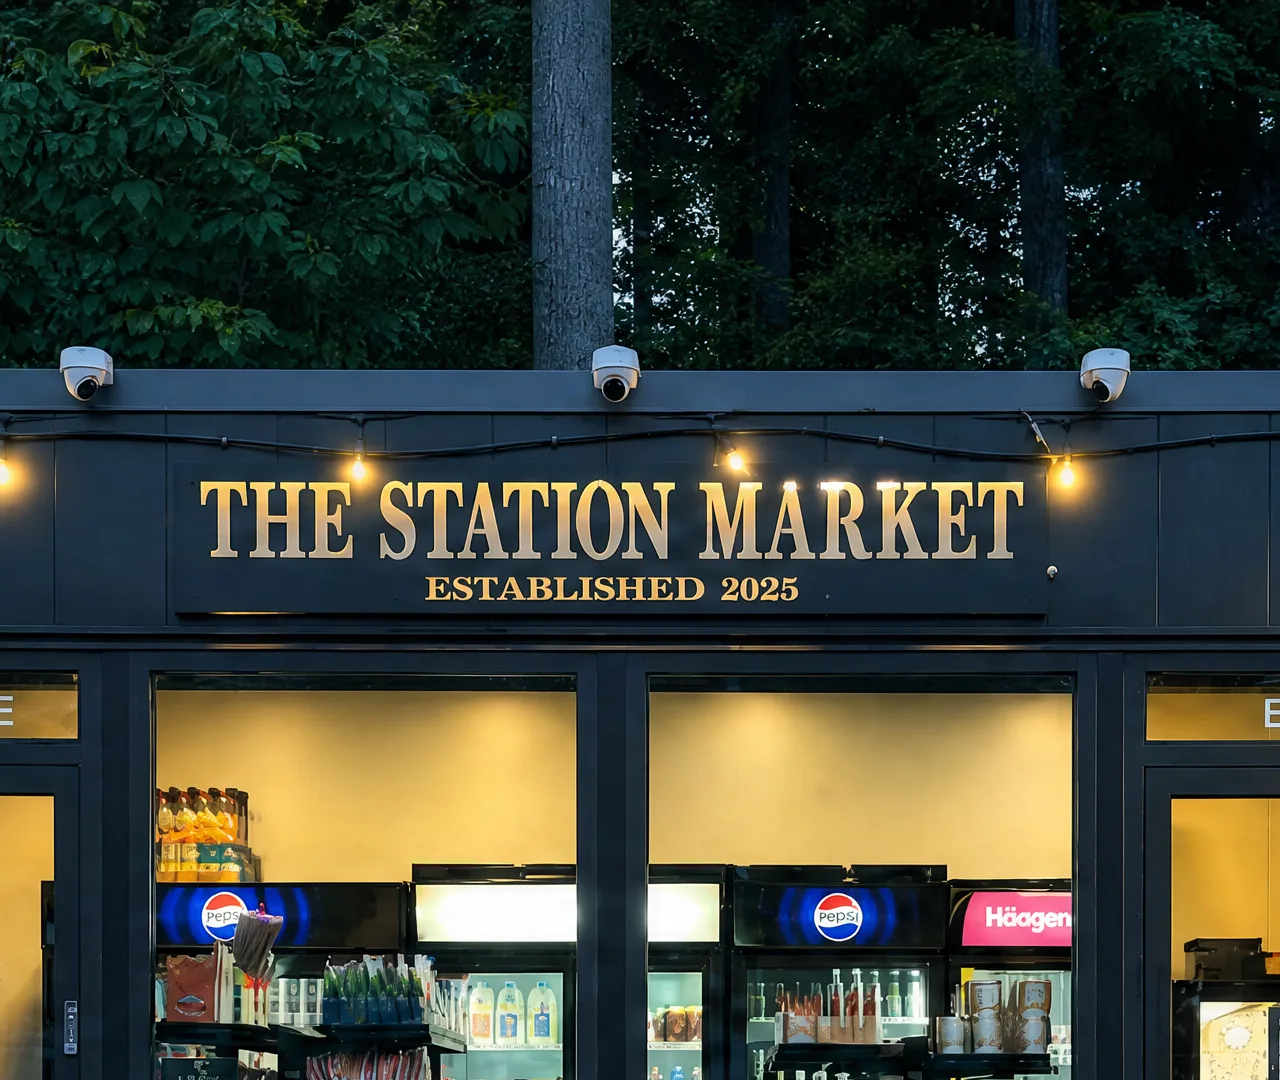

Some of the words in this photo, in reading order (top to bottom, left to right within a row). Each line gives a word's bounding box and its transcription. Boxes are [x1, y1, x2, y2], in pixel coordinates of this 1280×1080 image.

[201, 481, 353, 559] THE
[378, 479, 676, 561] STATION
[698, 479, 1024, 560] MARKET
[424, 576, 705, 602] ESTABLISHED
[720, 576, 799, 602] 2025
[206, 911, 239, 924] Peps
[985, 906, 1072, 933] Häagen
